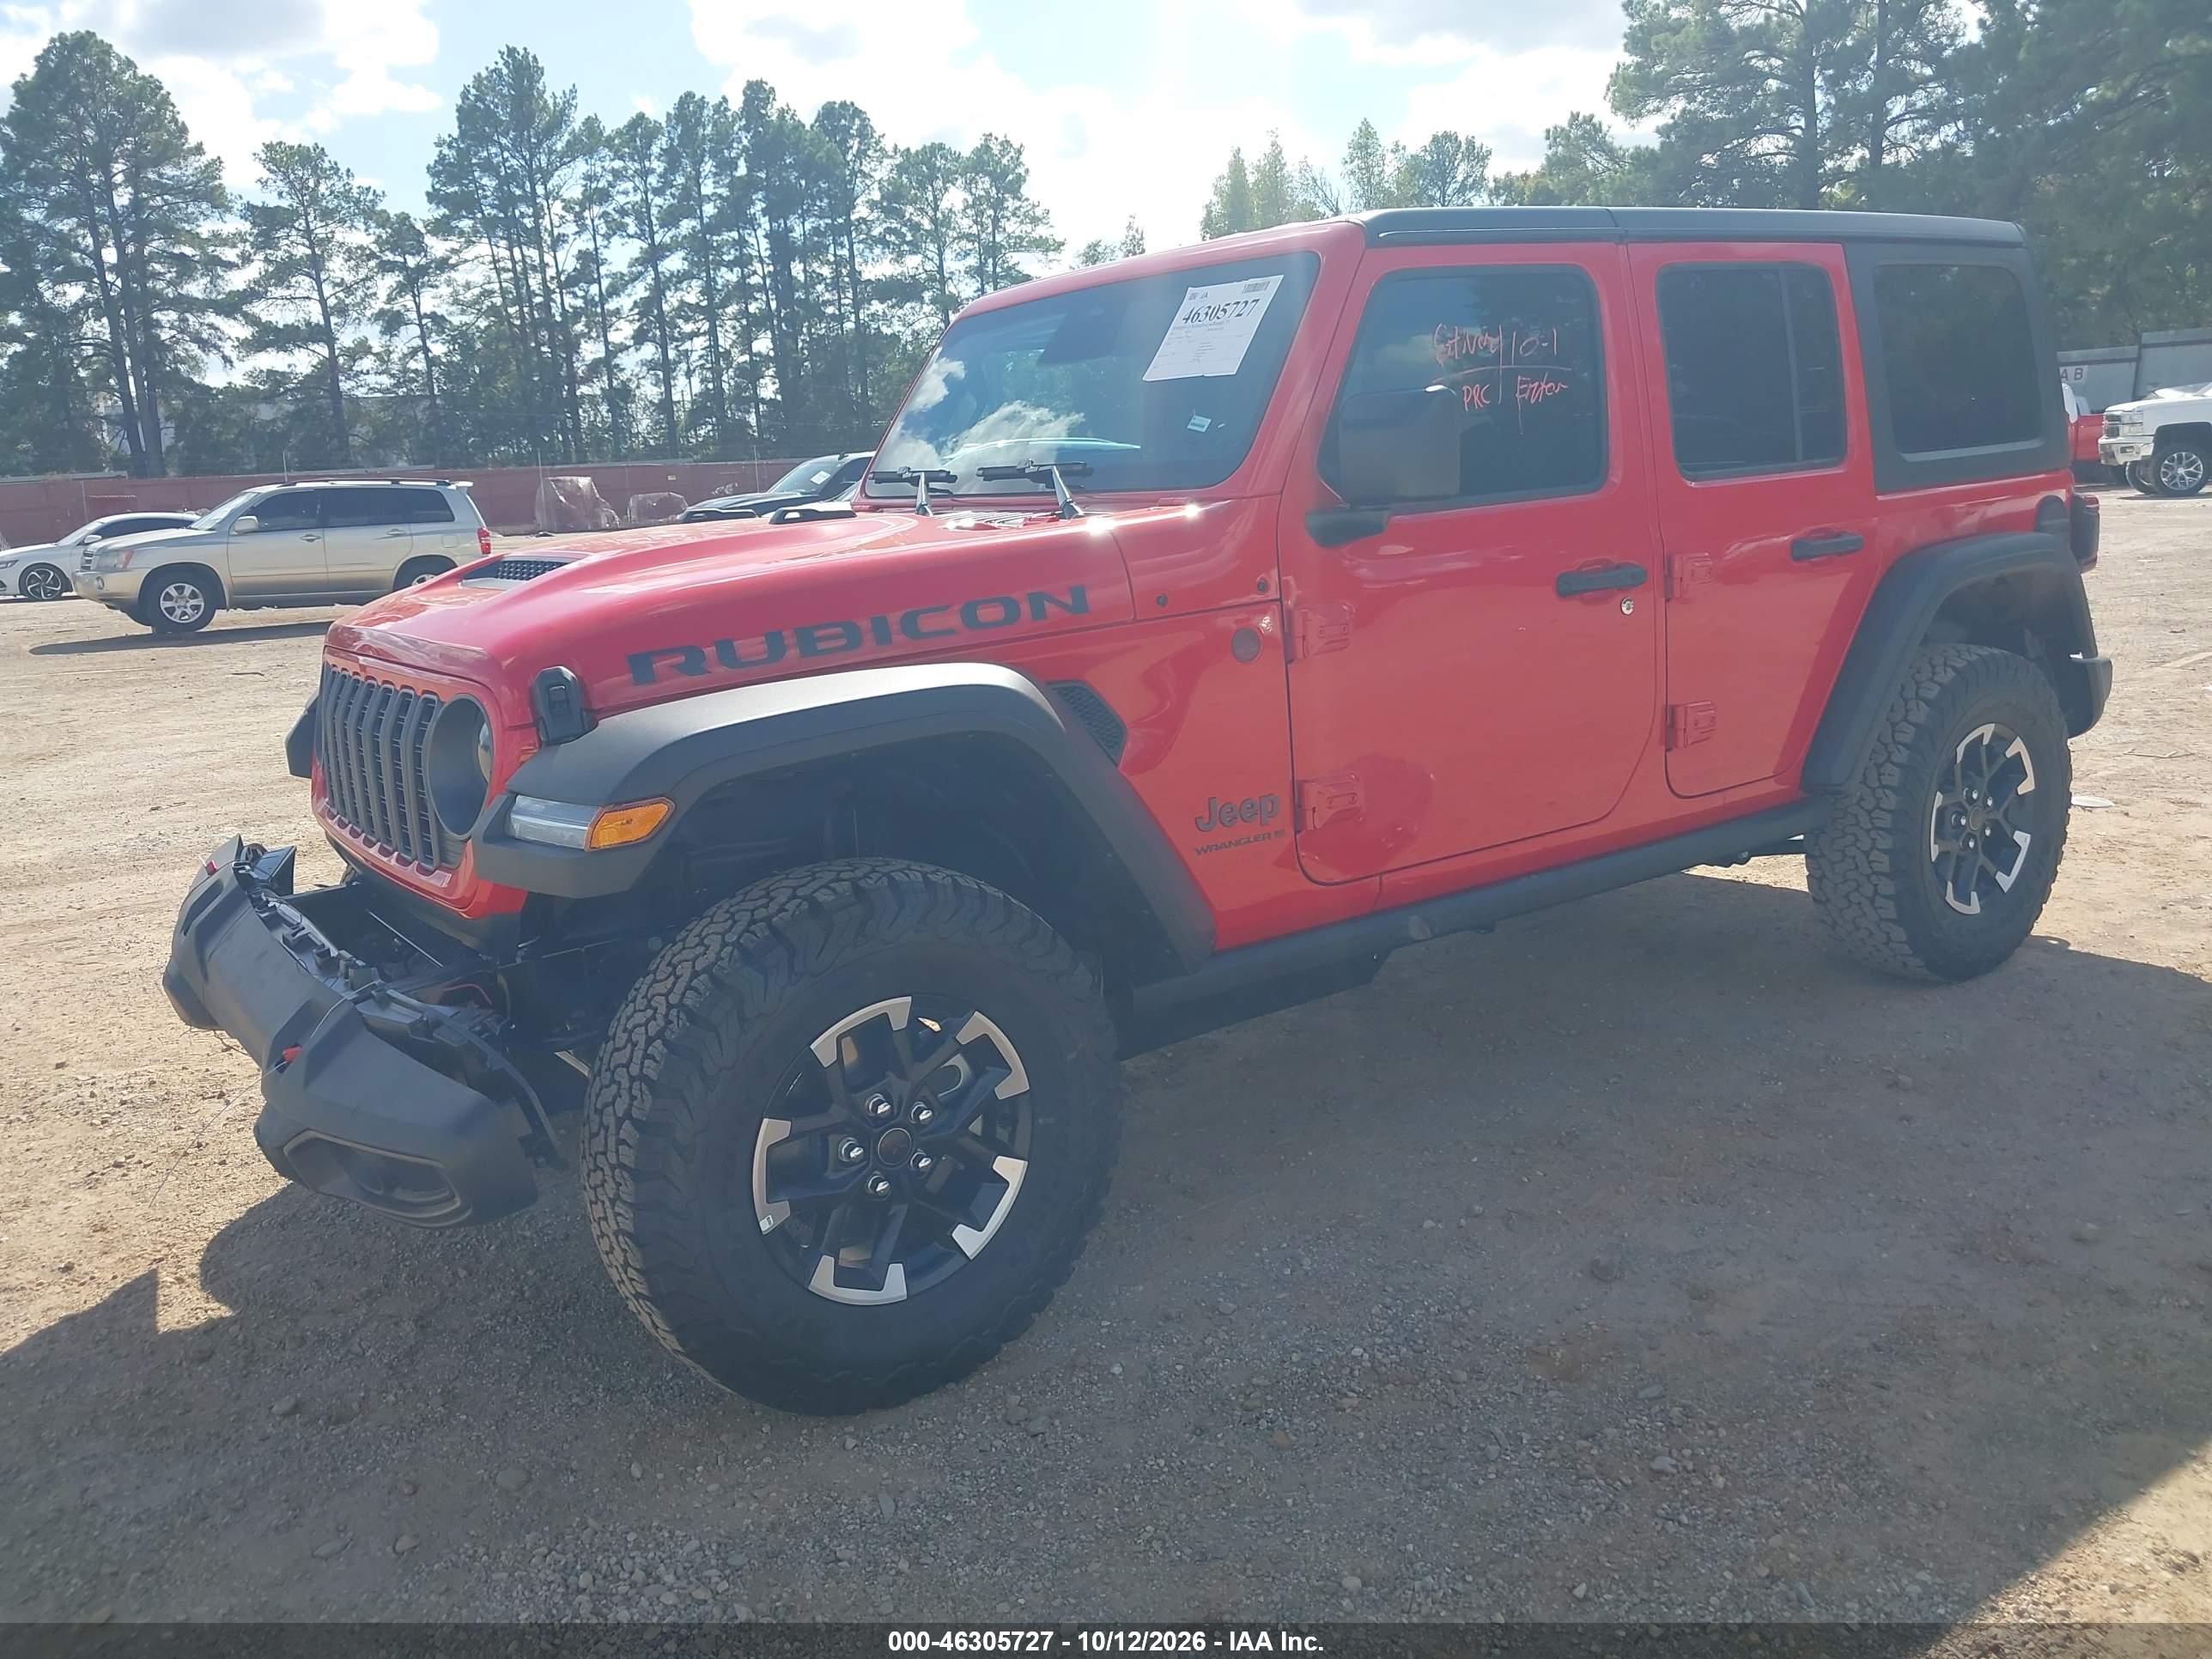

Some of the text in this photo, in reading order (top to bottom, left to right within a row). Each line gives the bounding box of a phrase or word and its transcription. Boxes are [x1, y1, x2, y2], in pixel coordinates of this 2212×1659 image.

[1182, 299, 1261, 324] 46305727
[627, 585, 1091, 686] RUBICON
[1194, 793, 1281, 833] Jeep
[1194, 831, 1272, 855] WRANGLER
